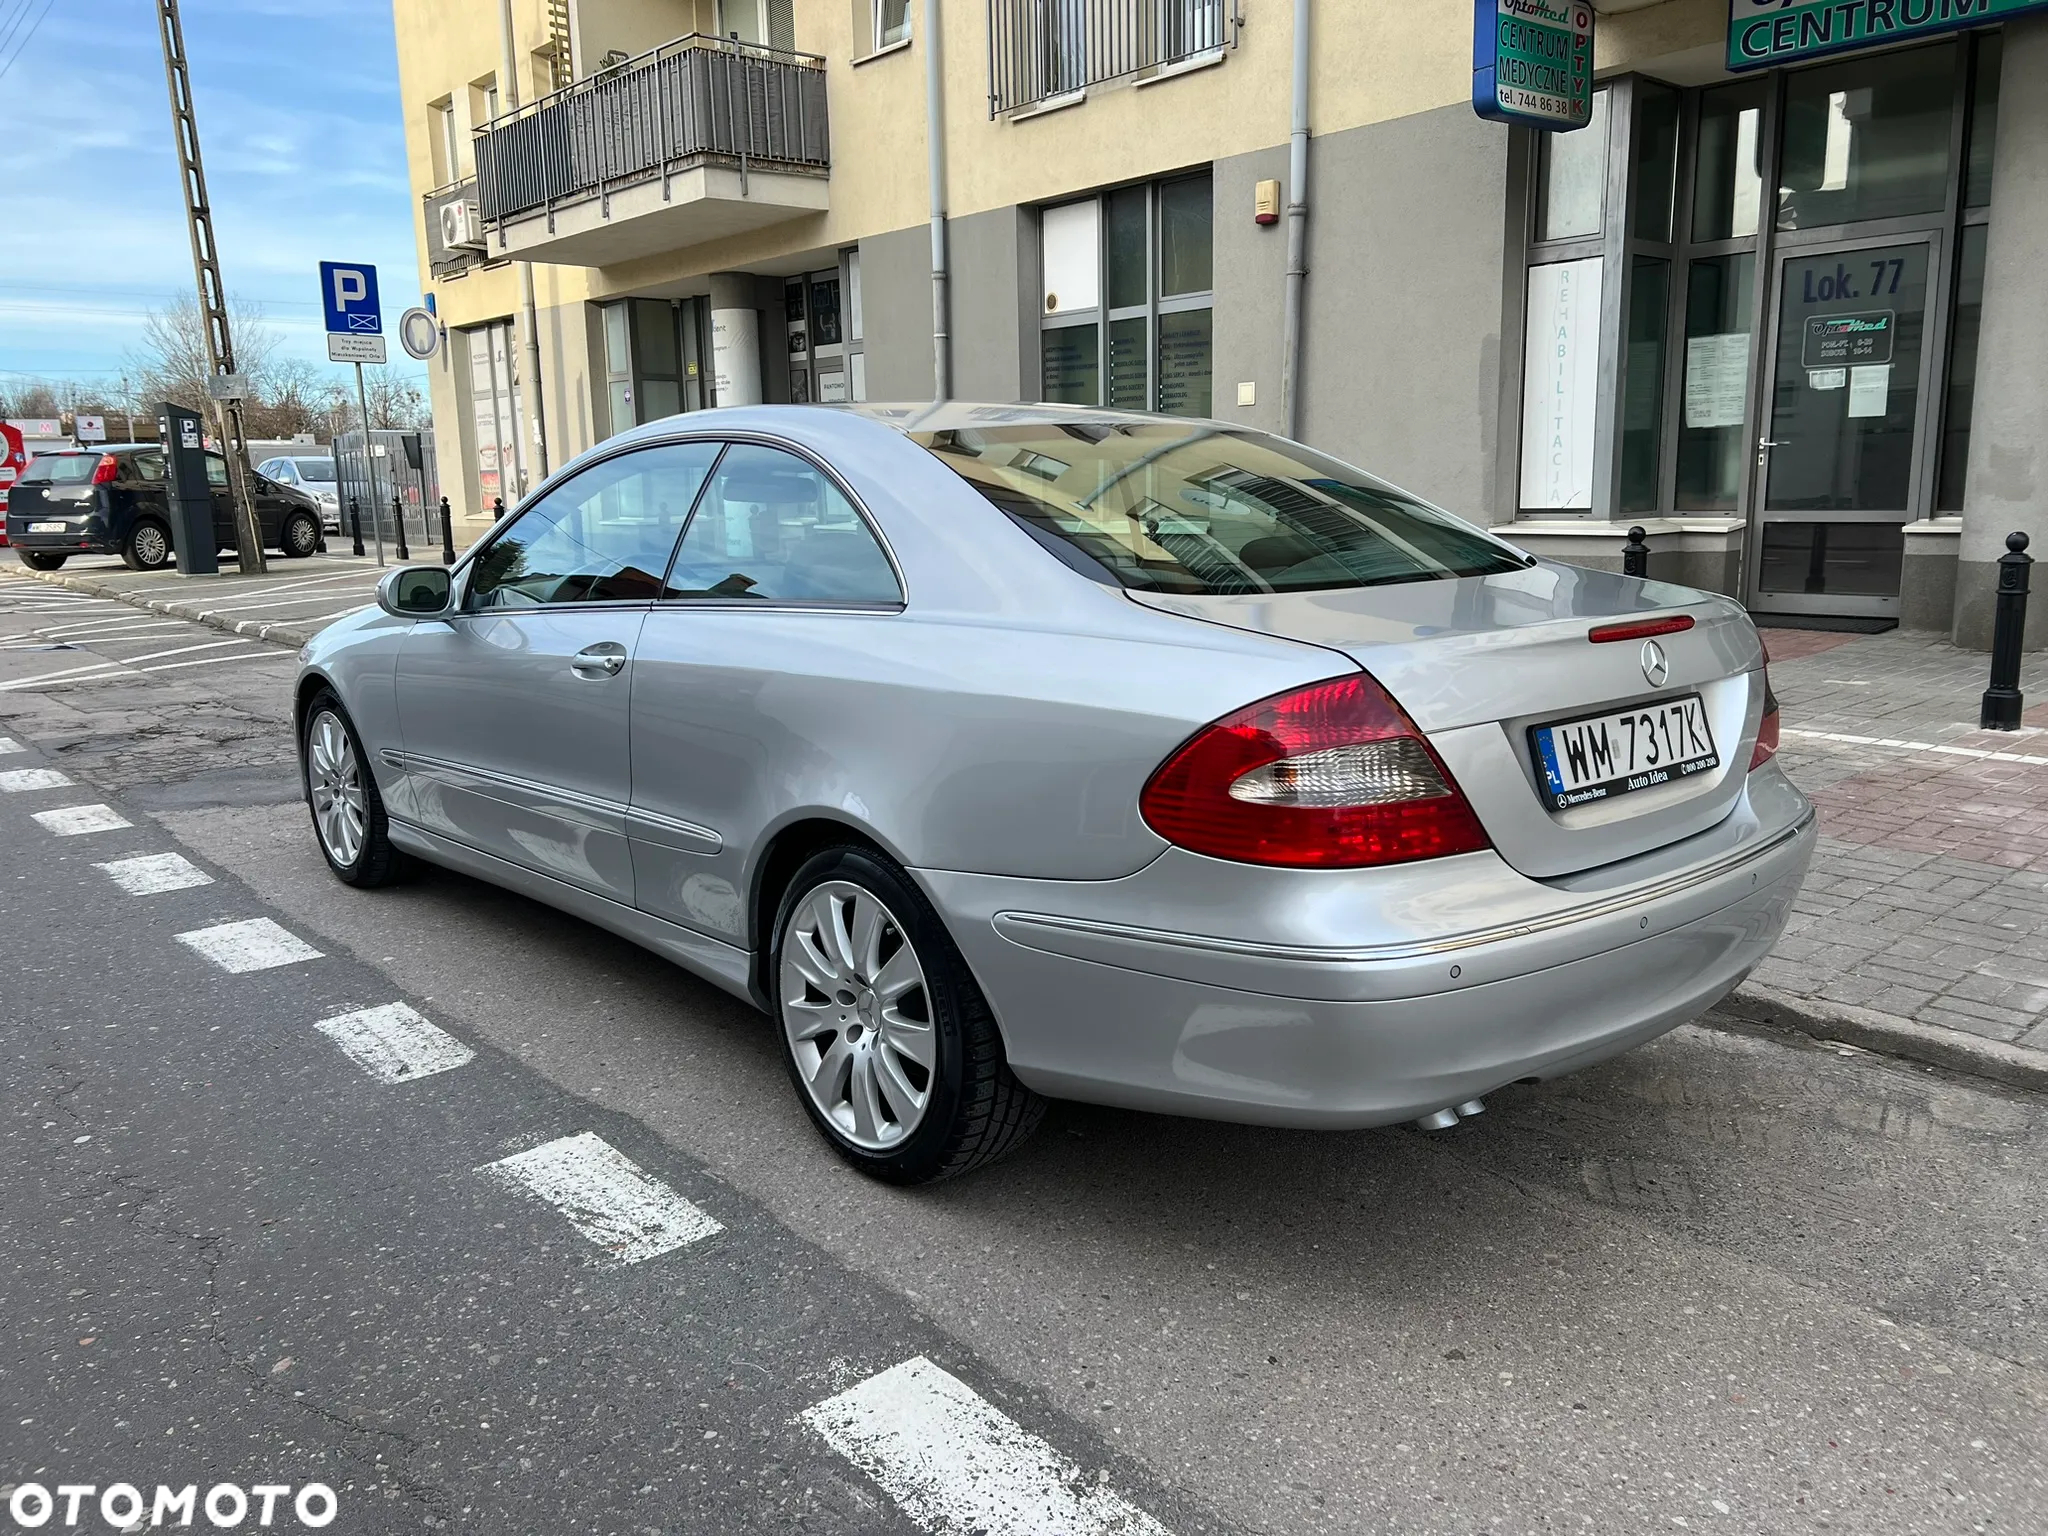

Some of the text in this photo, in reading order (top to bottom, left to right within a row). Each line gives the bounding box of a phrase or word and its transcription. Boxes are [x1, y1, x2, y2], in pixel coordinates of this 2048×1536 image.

[1500, 20, 1569, 61] CENTRUM
[1741, 0, 1989, 58] CENTRUM
[1499, 55, 1568, 94] MEDYCZNE
[1572, 11, 1588, 115] OPTYK
[1499, 89, 1568, 115] tel. 744 86 38
[333, 269, 367, 312] P
[1803, 258, 1905, 304] Lok. 77
[1550, 269, 1570, 503] REHABILITACJA
[183, 420, 195, 433] P
[1562, 702, 1707, 783] WM 7317K
[1546, 770, 1560, 785] PL
[1567, 788, 1607, 804] Mercedes-Benz
[1627, 776, 1649, 791] Auto
[1649, 770, 1669, 785] Idea
